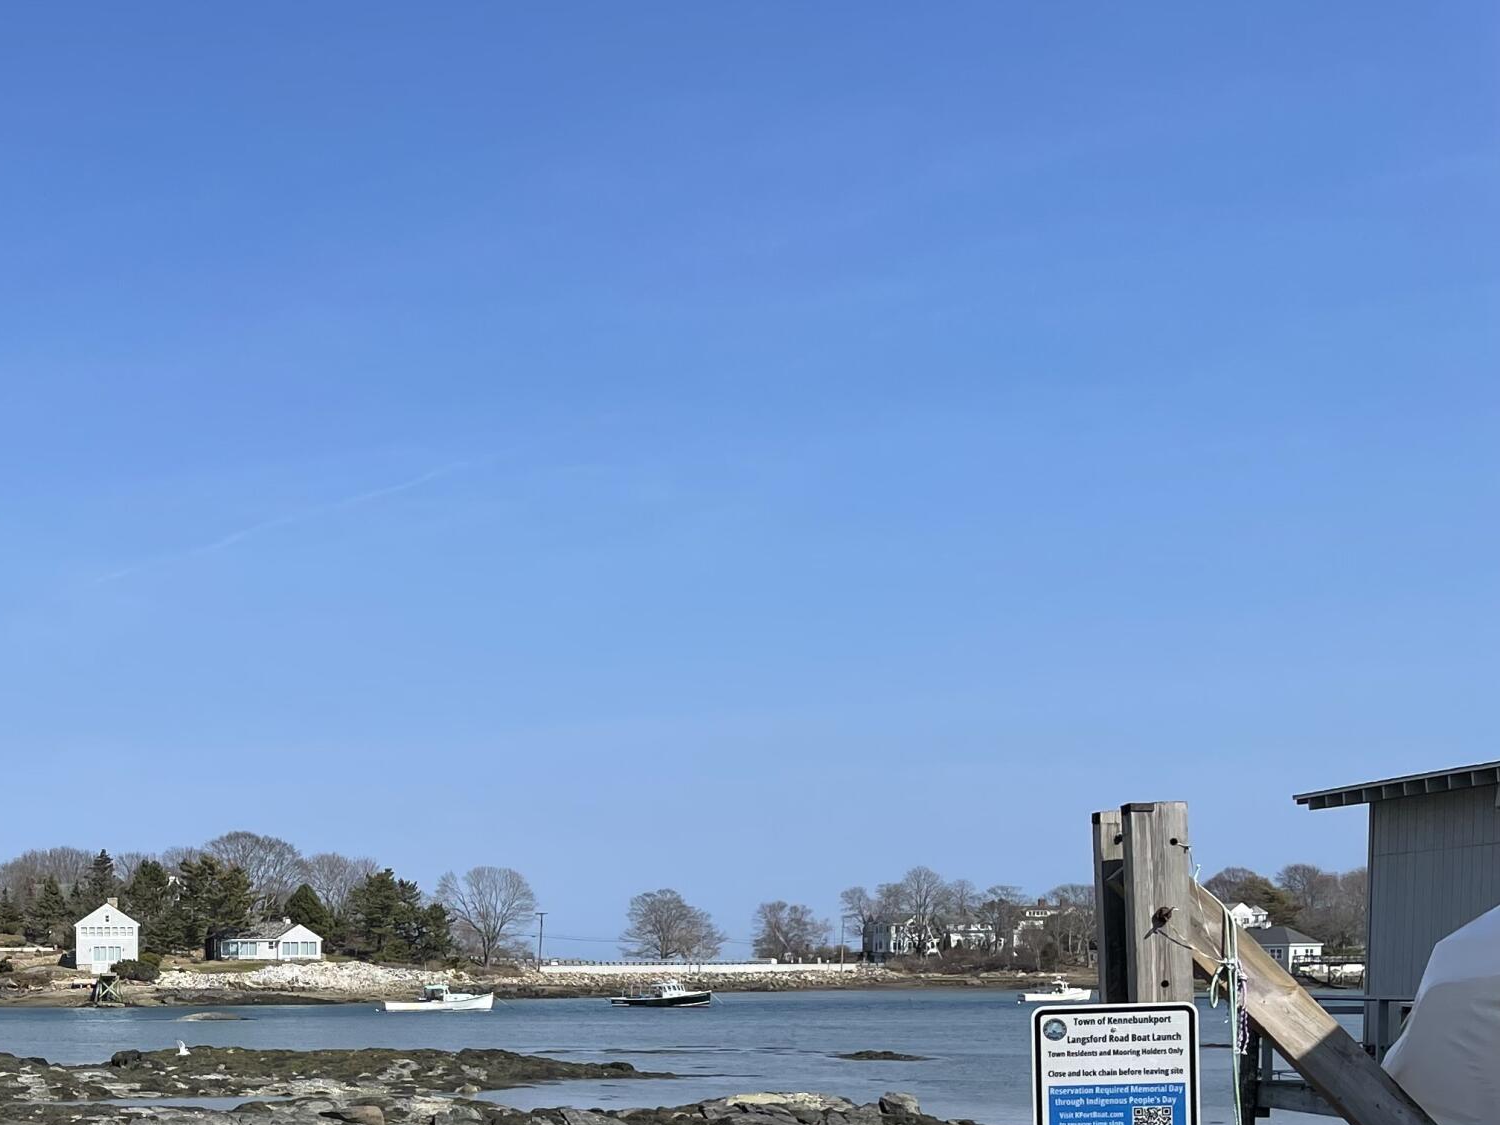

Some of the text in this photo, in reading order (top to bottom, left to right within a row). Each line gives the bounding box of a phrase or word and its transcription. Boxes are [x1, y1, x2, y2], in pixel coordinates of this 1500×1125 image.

[1074, 1016, 1171, 1026] Town of Kennebunkport
[1067, 1035, 1107, 1045] Langsford
[1152, 1033, 1181, 1041] Launch
[1113, 1049, 1140, 1057] Mooring
[1143, 1068, 1169, 1076] leaving
[1050, 1087, 1094, 1095] Reservation
[1130, 1085, 1168, 1093] Memorial
[1169, 1085, 1183, 1093] Day
[1055, 1097, 1085, 1107] through
[1086, 1097, 1127, 1106] Indigenous
[1163, 1096, 1177, 1105] Day
